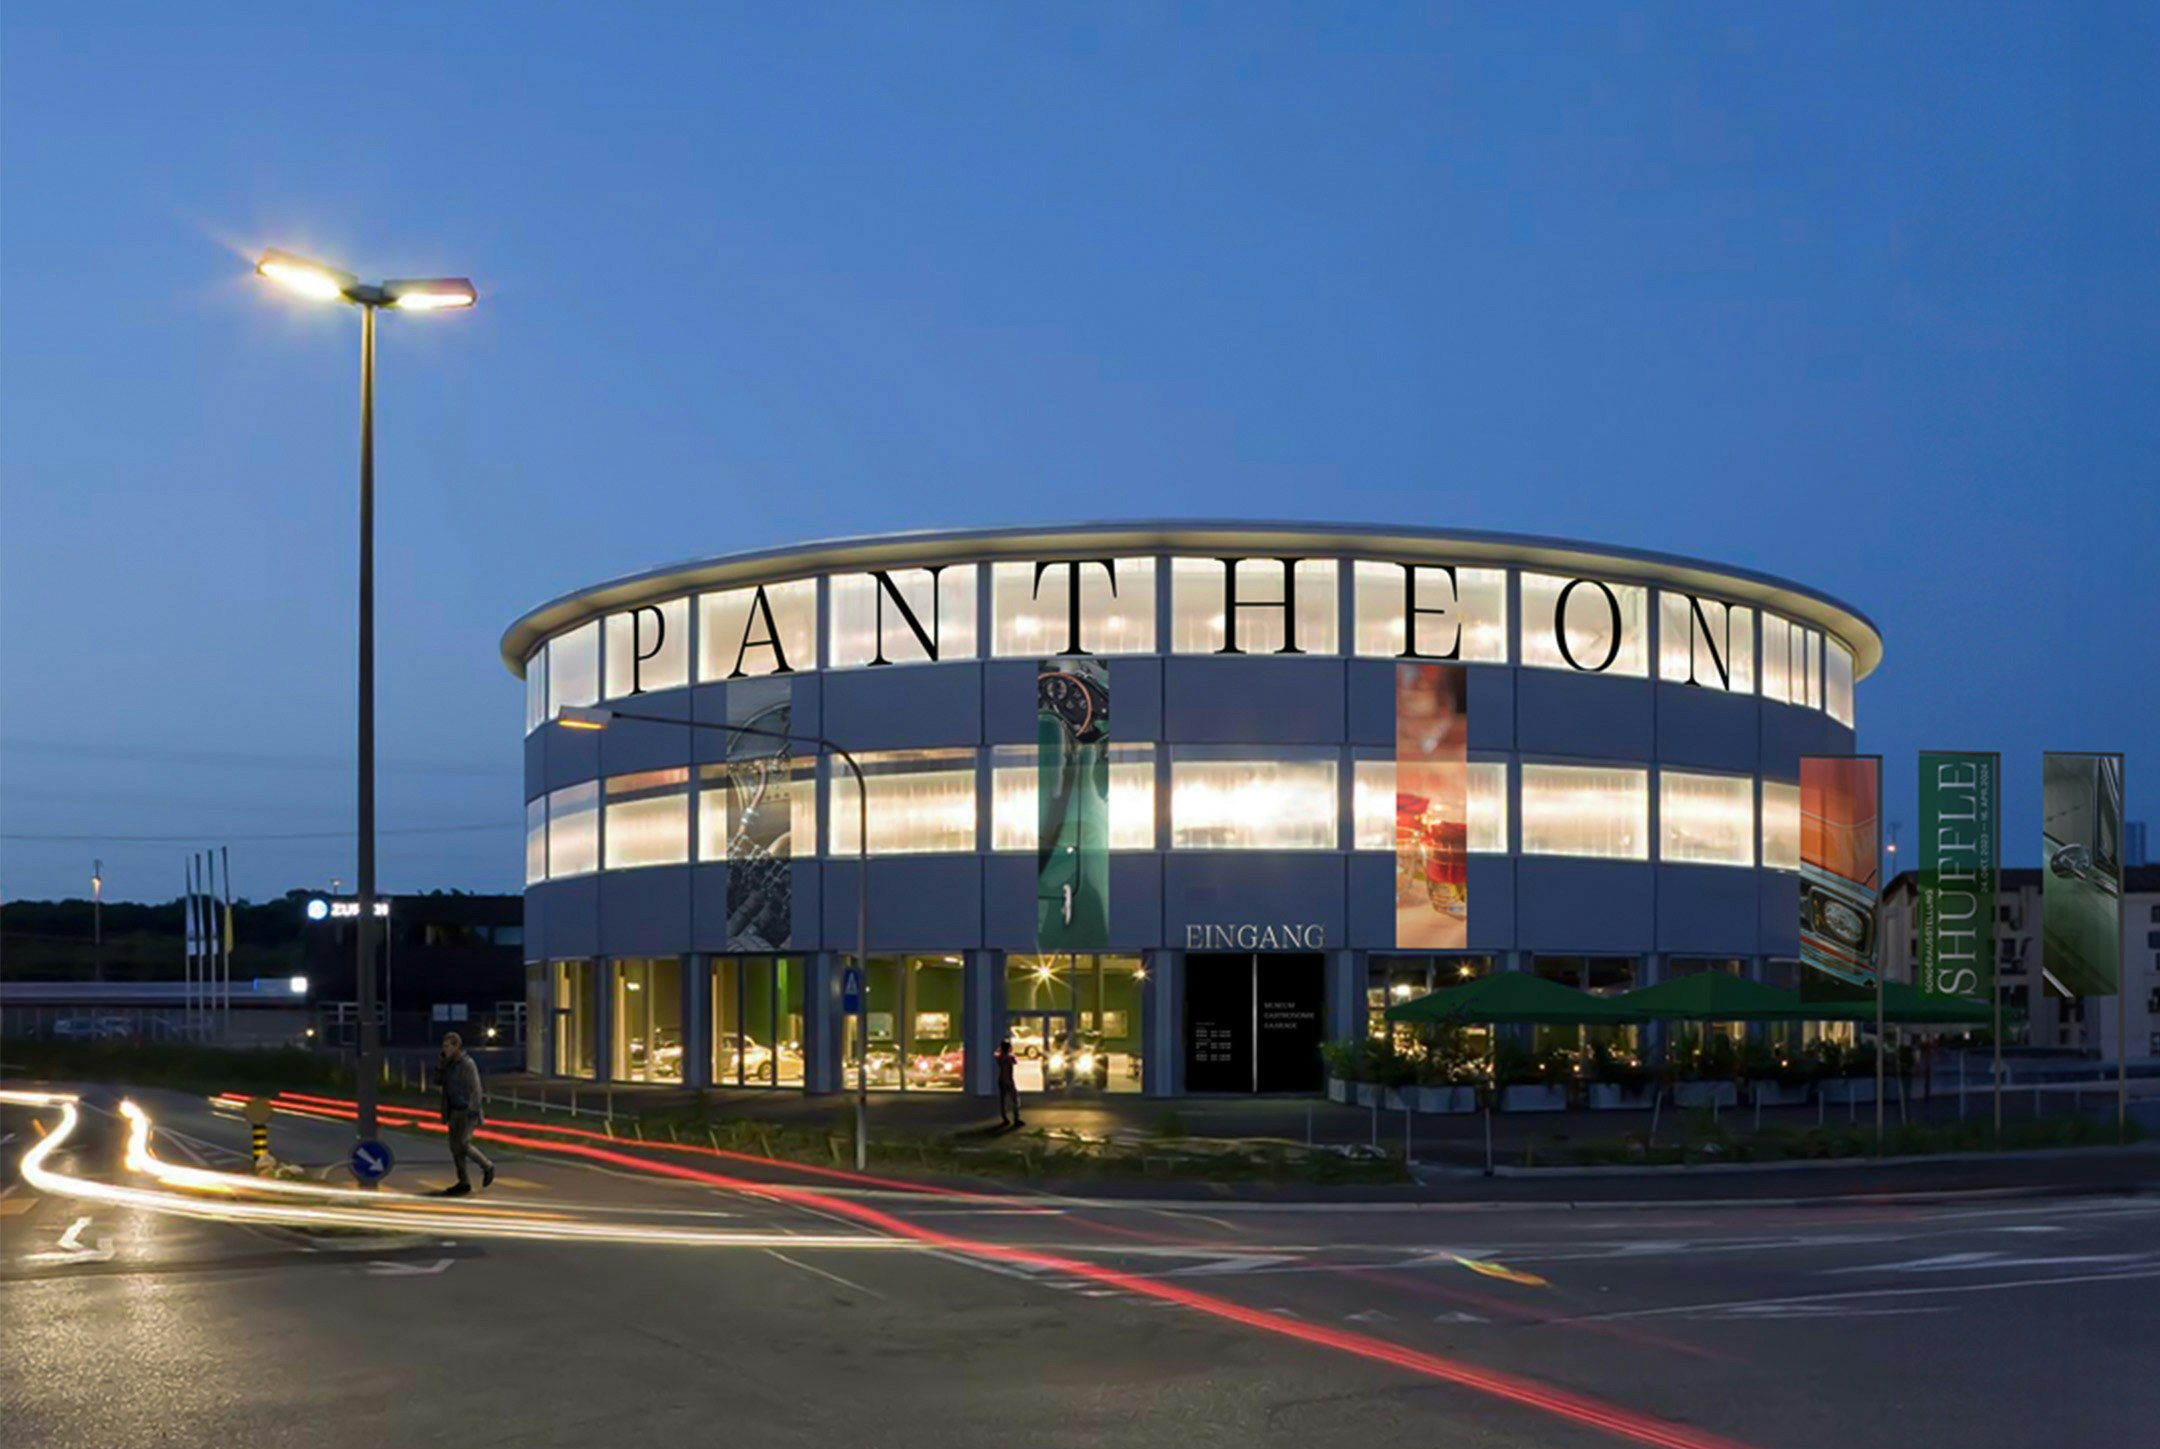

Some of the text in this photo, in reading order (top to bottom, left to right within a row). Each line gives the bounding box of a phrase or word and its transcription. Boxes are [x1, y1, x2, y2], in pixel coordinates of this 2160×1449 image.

[630, 557, 1736, 694] PANTHEON
[1185, 924, 1326, 949] EINGANG
[1937, 761, 1977, 995] SHUFFLE
[1925, 889, 1934, 994] SONDERAUSSTELLUNG
